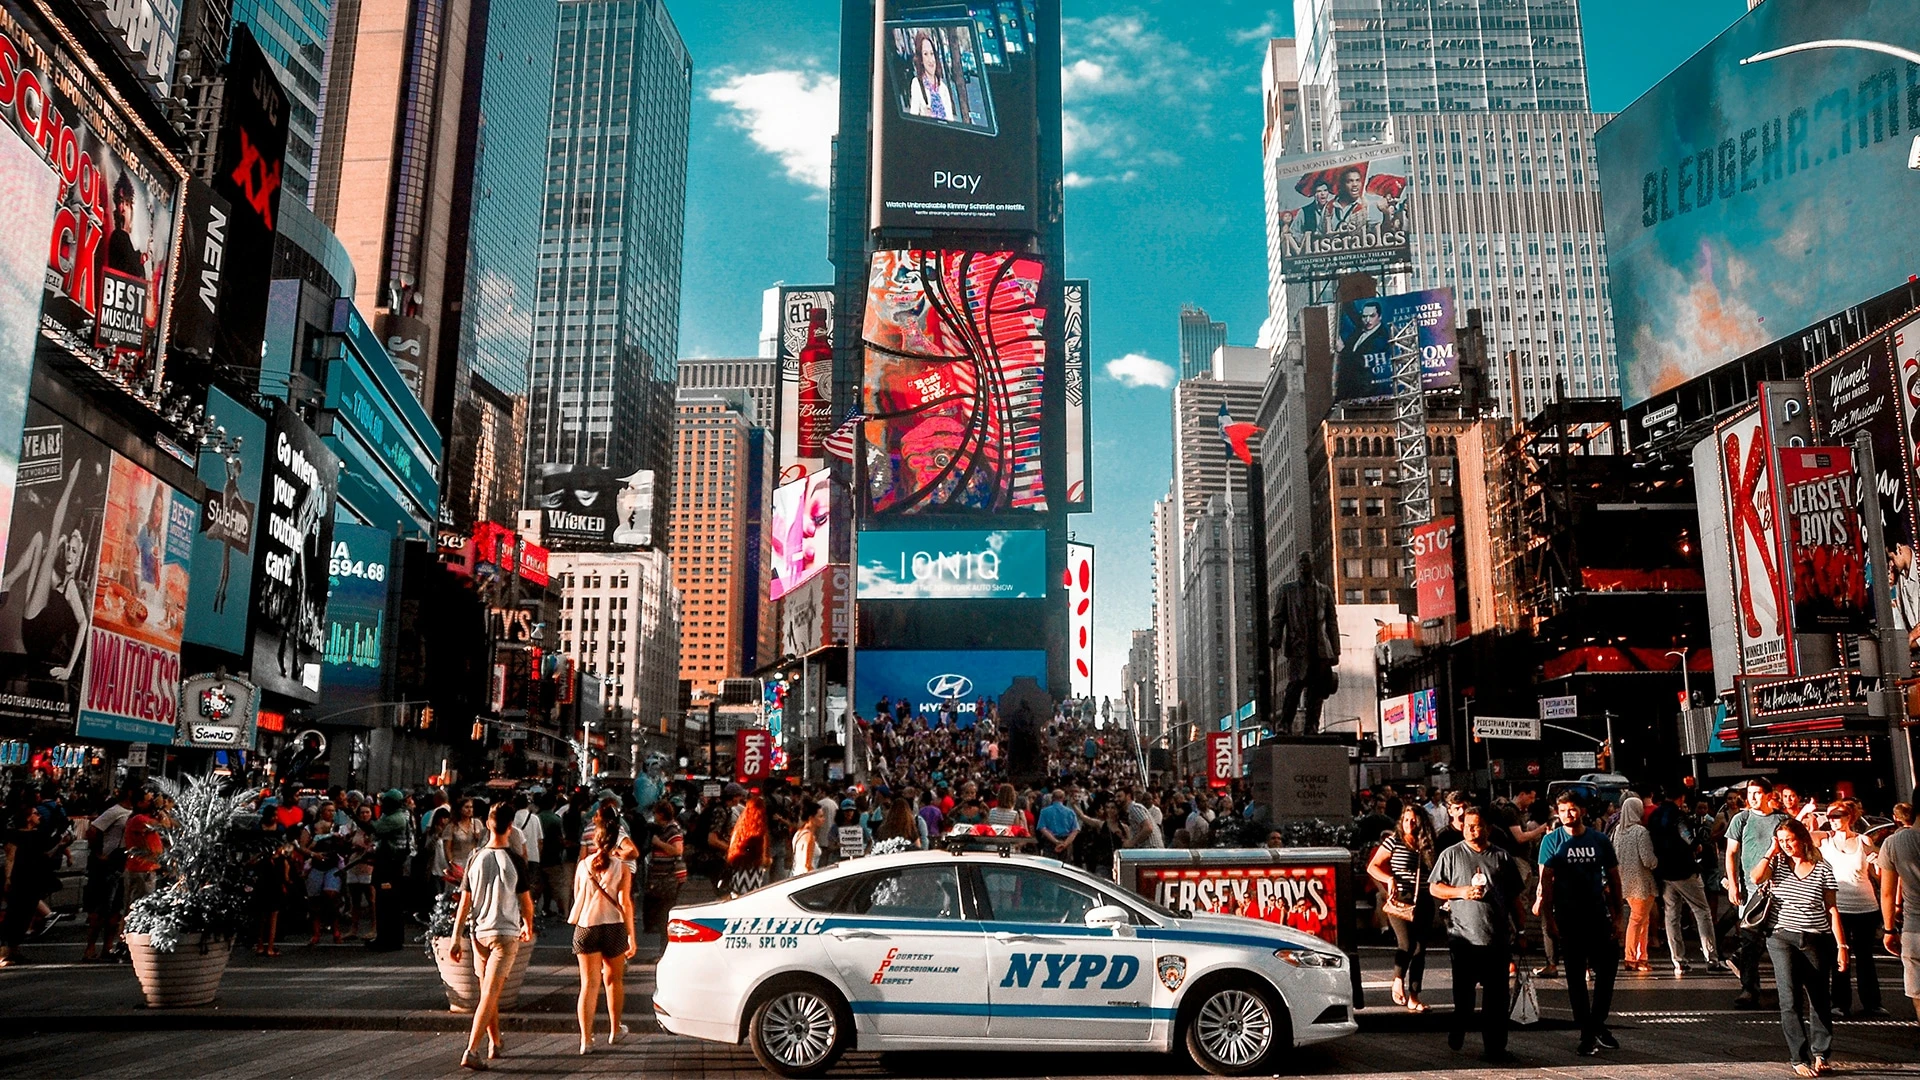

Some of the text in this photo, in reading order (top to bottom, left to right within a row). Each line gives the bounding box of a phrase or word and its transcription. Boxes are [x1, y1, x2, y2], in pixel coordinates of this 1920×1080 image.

[35, 44, 55, 80] THE
[106, 124, 141, 174] MESSAGE
[139, 164, 150, 183] OF
[0, 33, 105, 223] SCHOOL
[1279, 165, 1301, 176] FINAL
[1302, 159, 1337, 172] MONTHS
[933, 171, 981, 194] Play
[886, 201, 907, 209] Watch
[907, 202, 946, 210] Unbreakable
[947, 203, 968, 211] Kimmy
[969, 203, 995, 211] Schmidt
[1326, 216, 1357, 234] Les
[1282, 223, 1406, 257] Misérables
[50, 207, 103, 318] CK
[199, 204, 227, 314] NEW
[1338, 252, 1367, 261] IMPERIAL
[1367, 249, 1396, 258] THEATRE
[102, 277, 145, 315] BEST
[1394, 302, 1442, 315] LET YOUR
[101, 307, 144, 333] MUSICAL!
[1363, 343, 1454, 367] PHOM
[1371, 366, 1386, 374] OF
[1829, 354, 1872, 398] Winner!
[921, 381, 941, 395] day
[1832, 382, 1870, 413] 4 TONY AWARDS
[1829, 412, 1850, 438] Best
[1849, 394, 1885, 425] Musical!
[23, 432, 61, 457] YEARS
[277, 432, 321, 492] Go where
[273, 473, 297, 510] your
[1789, 475, 1853, 515] JERSEY
[170, 500, 195, 531] BEST
[1800, 509, 1848, 547] BOYS
[269, 511, 302, 555] routine
[330, 541, 350, 560] IA
[265, 550, 293, 588] can't.
[328, 559, 386, 582] 694.68
[901, 550, 1000, 581] IONIQ
[1418, 563, 1455, 584] AROUN
[972, 584, 991, 592] AUTO
[991, 584, 1014, 592] SHOW
[831, 568, 850, 644] HELLO!
[1766, 653, 1779, 662] BEST
[1767, 640, 1779, 654] TONY
[87, 629, 178, 724] WAITRESS
[1772, 684, 1804, 710] American
[1477, 719, 1531, 728] PEDESTRIAN FLOW ZONE
[1499, 728, 1532, 737] KEEP MOVING
[743, 733, 766, 775] tkts
[1293, 775, 1329, 784] GEORGE
[1567, 846, 1596, 858] ANU
[1256, 876, 1329, 920] BOYS
[722, 917, 825, 936] TRAFFIC
[759, 937, 776, 949] SPL
[779, 937, 798, 949] OPS
[886, 947, 934, 961] COURTESY
[870, 972, 914, 985] RESPECT
[878, 960, 960, 974] PROFESSIONALISM
[999, 953, 1140, 990] NYPD
